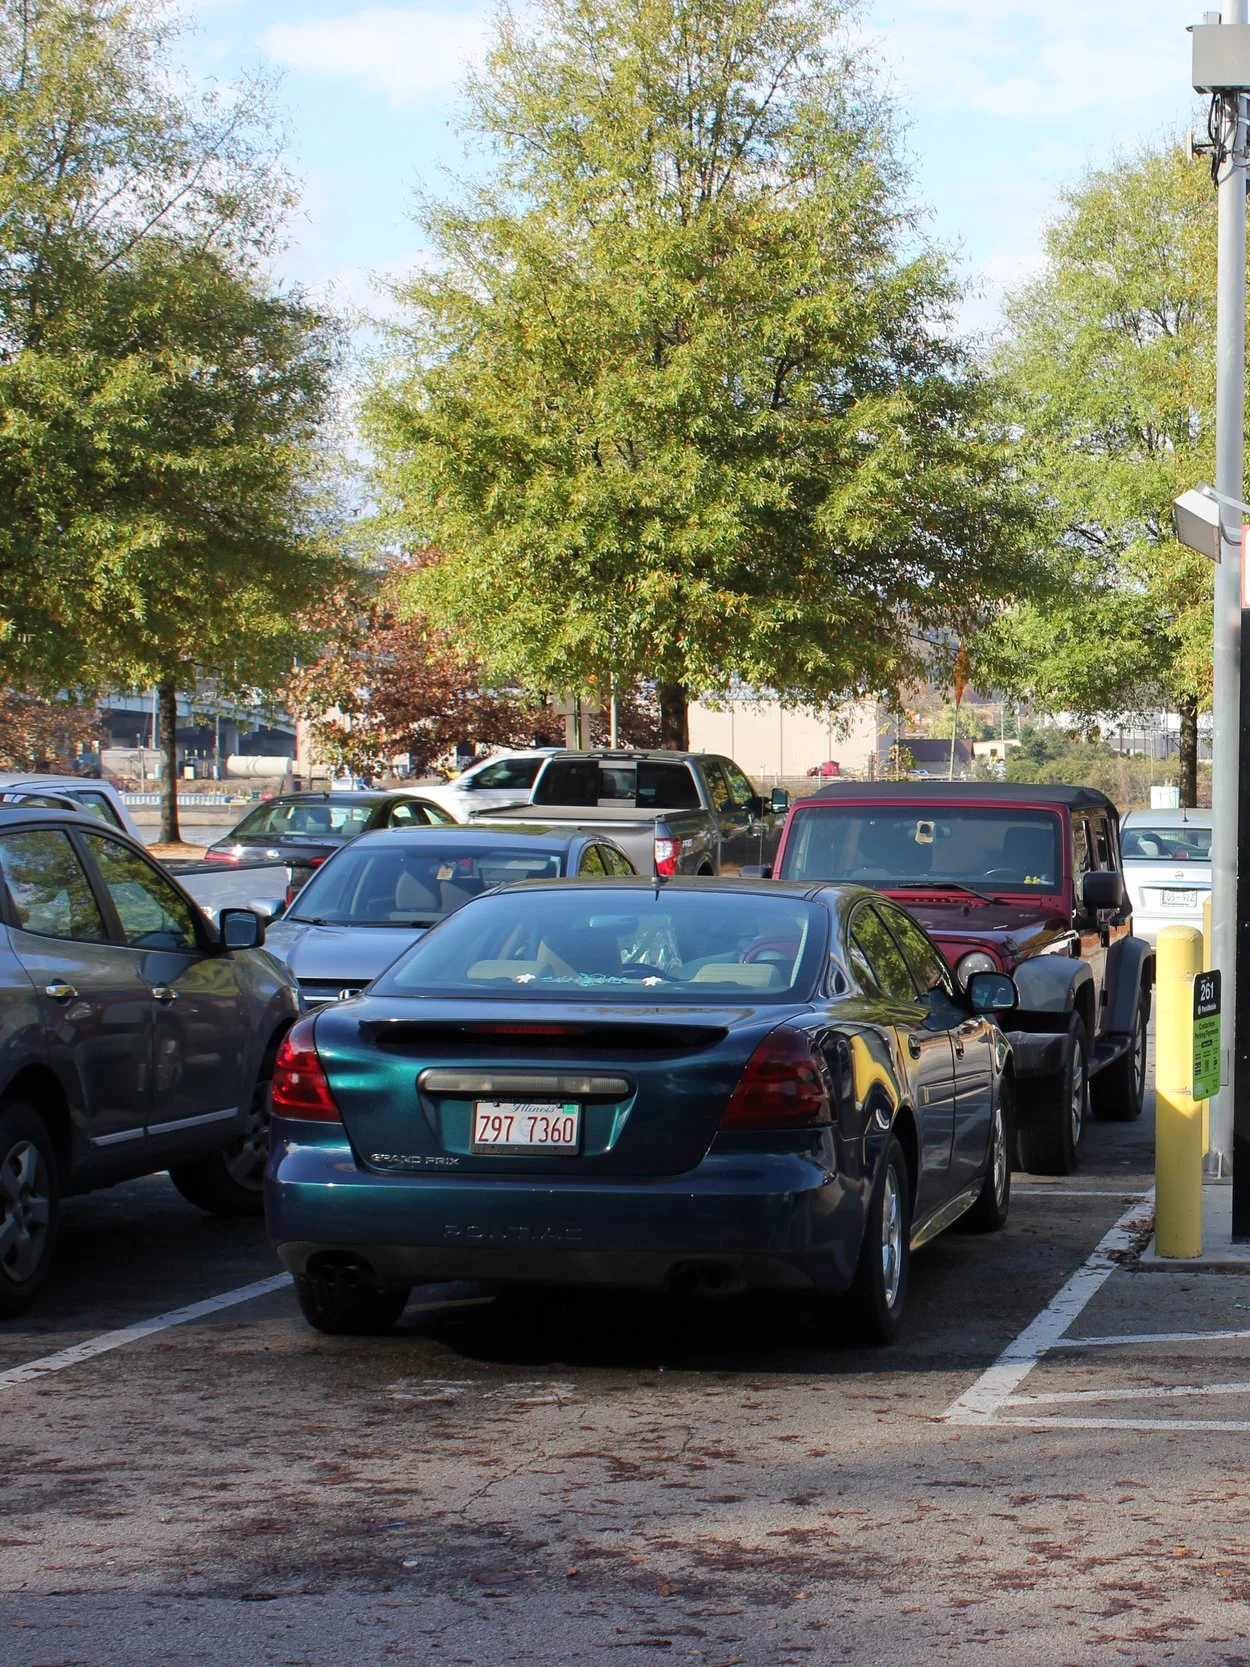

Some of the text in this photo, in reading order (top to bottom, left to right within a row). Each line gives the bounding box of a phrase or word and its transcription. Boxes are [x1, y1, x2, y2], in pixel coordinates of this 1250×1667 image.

[1200, 981, 1214, 1002] 261
[511, 1104, 555, 1114] Illinois
[478, 1115, 574, 1144] Z97 7360
[370, 1153, 461, 1166] GRAND PRIX
